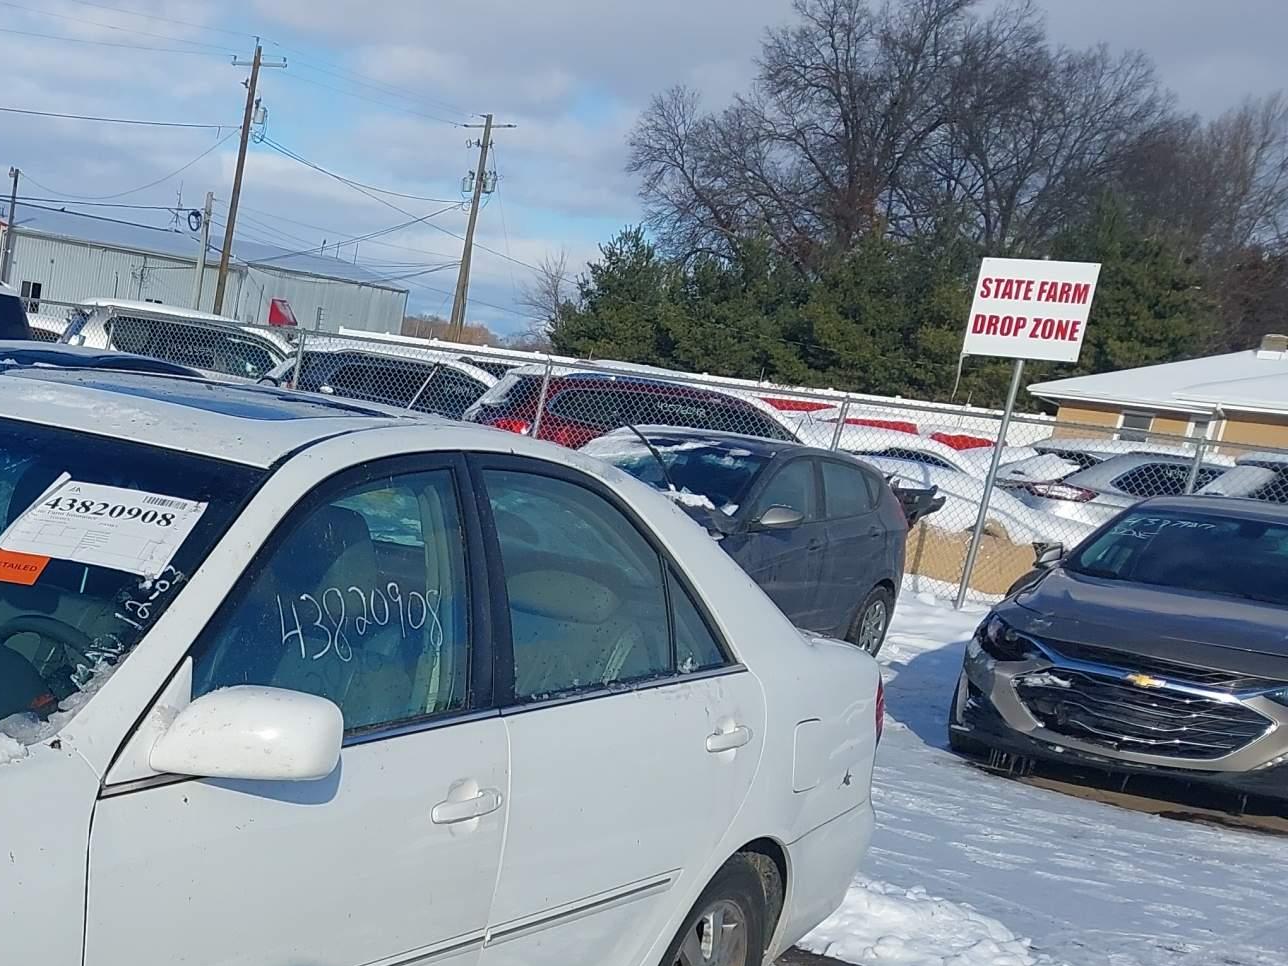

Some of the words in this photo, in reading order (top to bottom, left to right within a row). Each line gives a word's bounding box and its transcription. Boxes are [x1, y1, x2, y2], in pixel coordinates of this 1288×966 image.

[979, 277, 1035, 301] STATE
[1036, 280, 1091, 305] FARM
[971, 313, 1028, 337] DROP
[1028, 317, 1082, 342] ZONE
[44, 496, 176, 527] 43820908
[276, 582, 444, 662] 43820908
